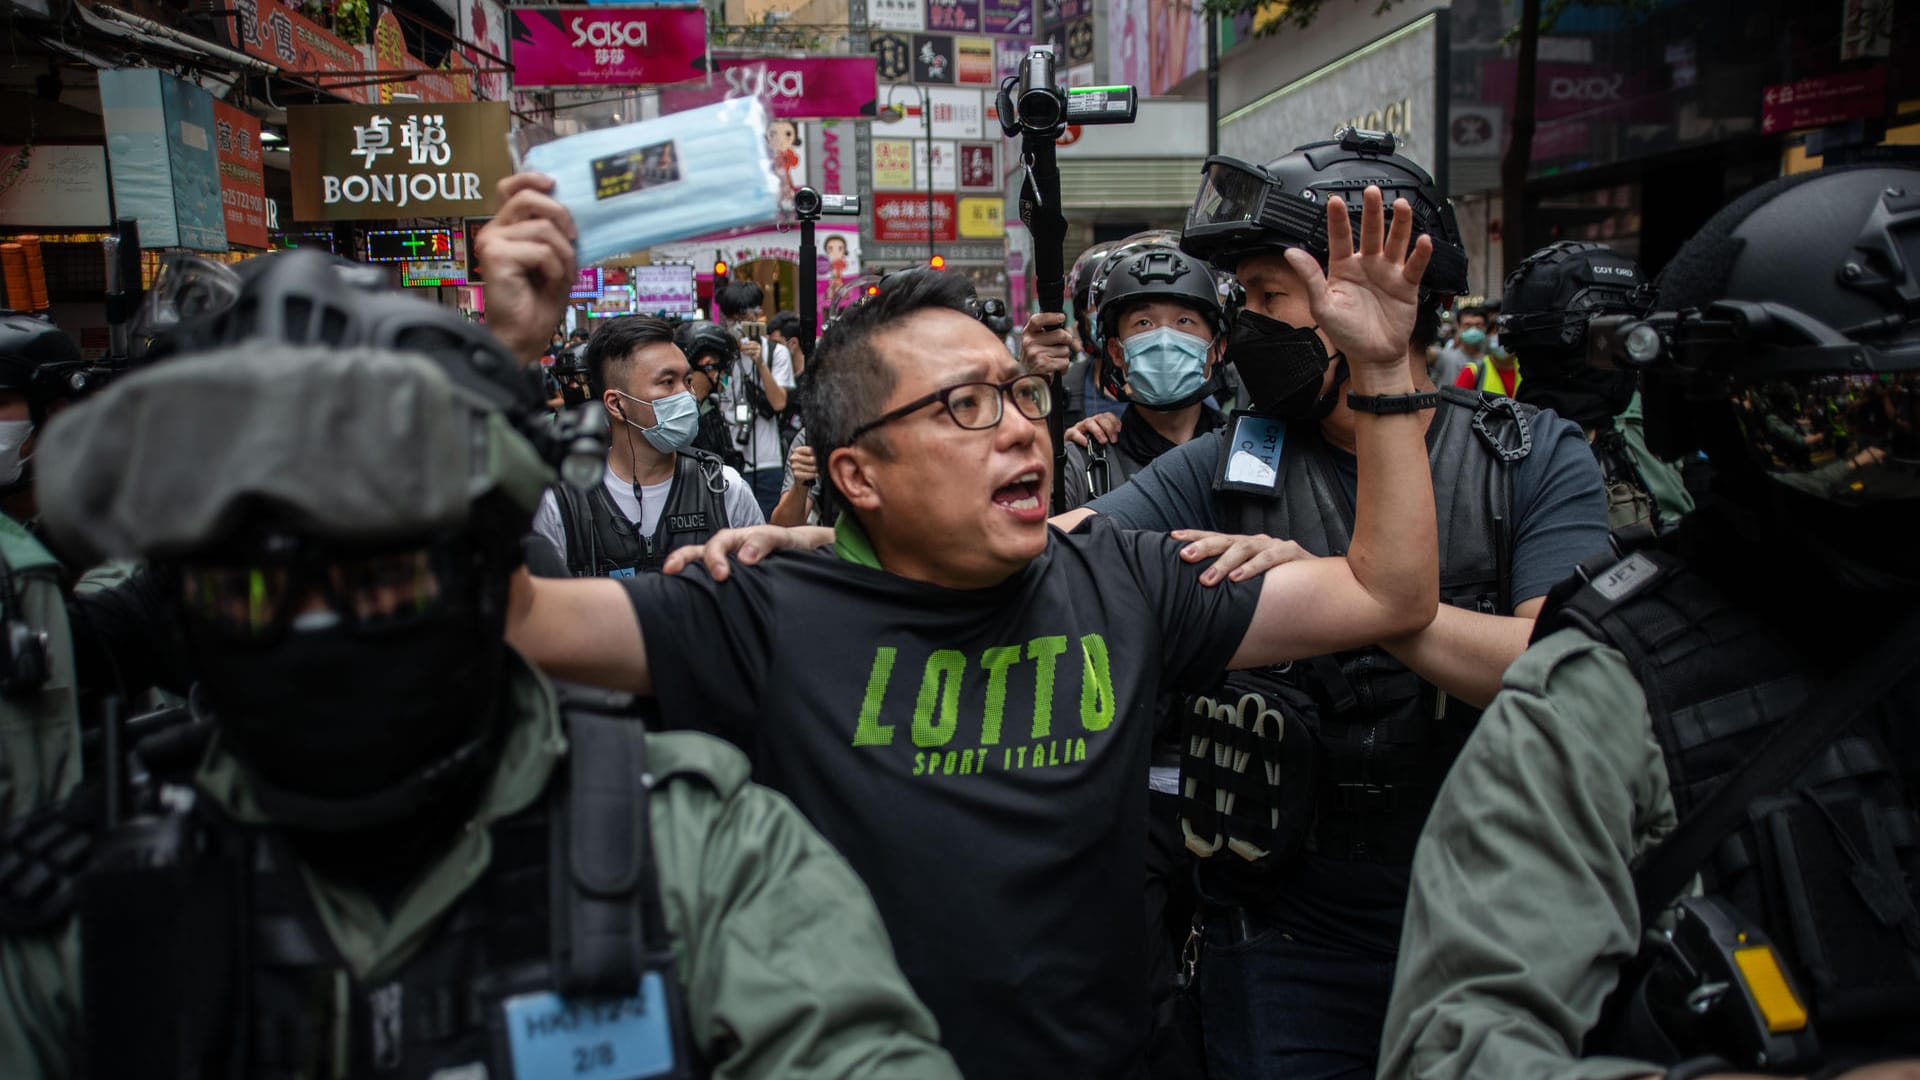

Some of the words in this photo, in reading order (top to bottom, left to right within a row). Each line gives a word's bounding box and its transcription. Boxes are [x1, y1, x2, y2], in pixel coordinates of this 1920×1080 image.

[594, 48, 626, 65] 莎莎
[322, 172, 483, 207] BONJOUR
[670, 514, 705, 529] POLICE
[1608, 561, 1636, 587] JET
[852, 633, 1116, 748] LOTTO
[912, 748, 988, 776] SPORT
[1004, 737, 1086, 770] ITALIA
